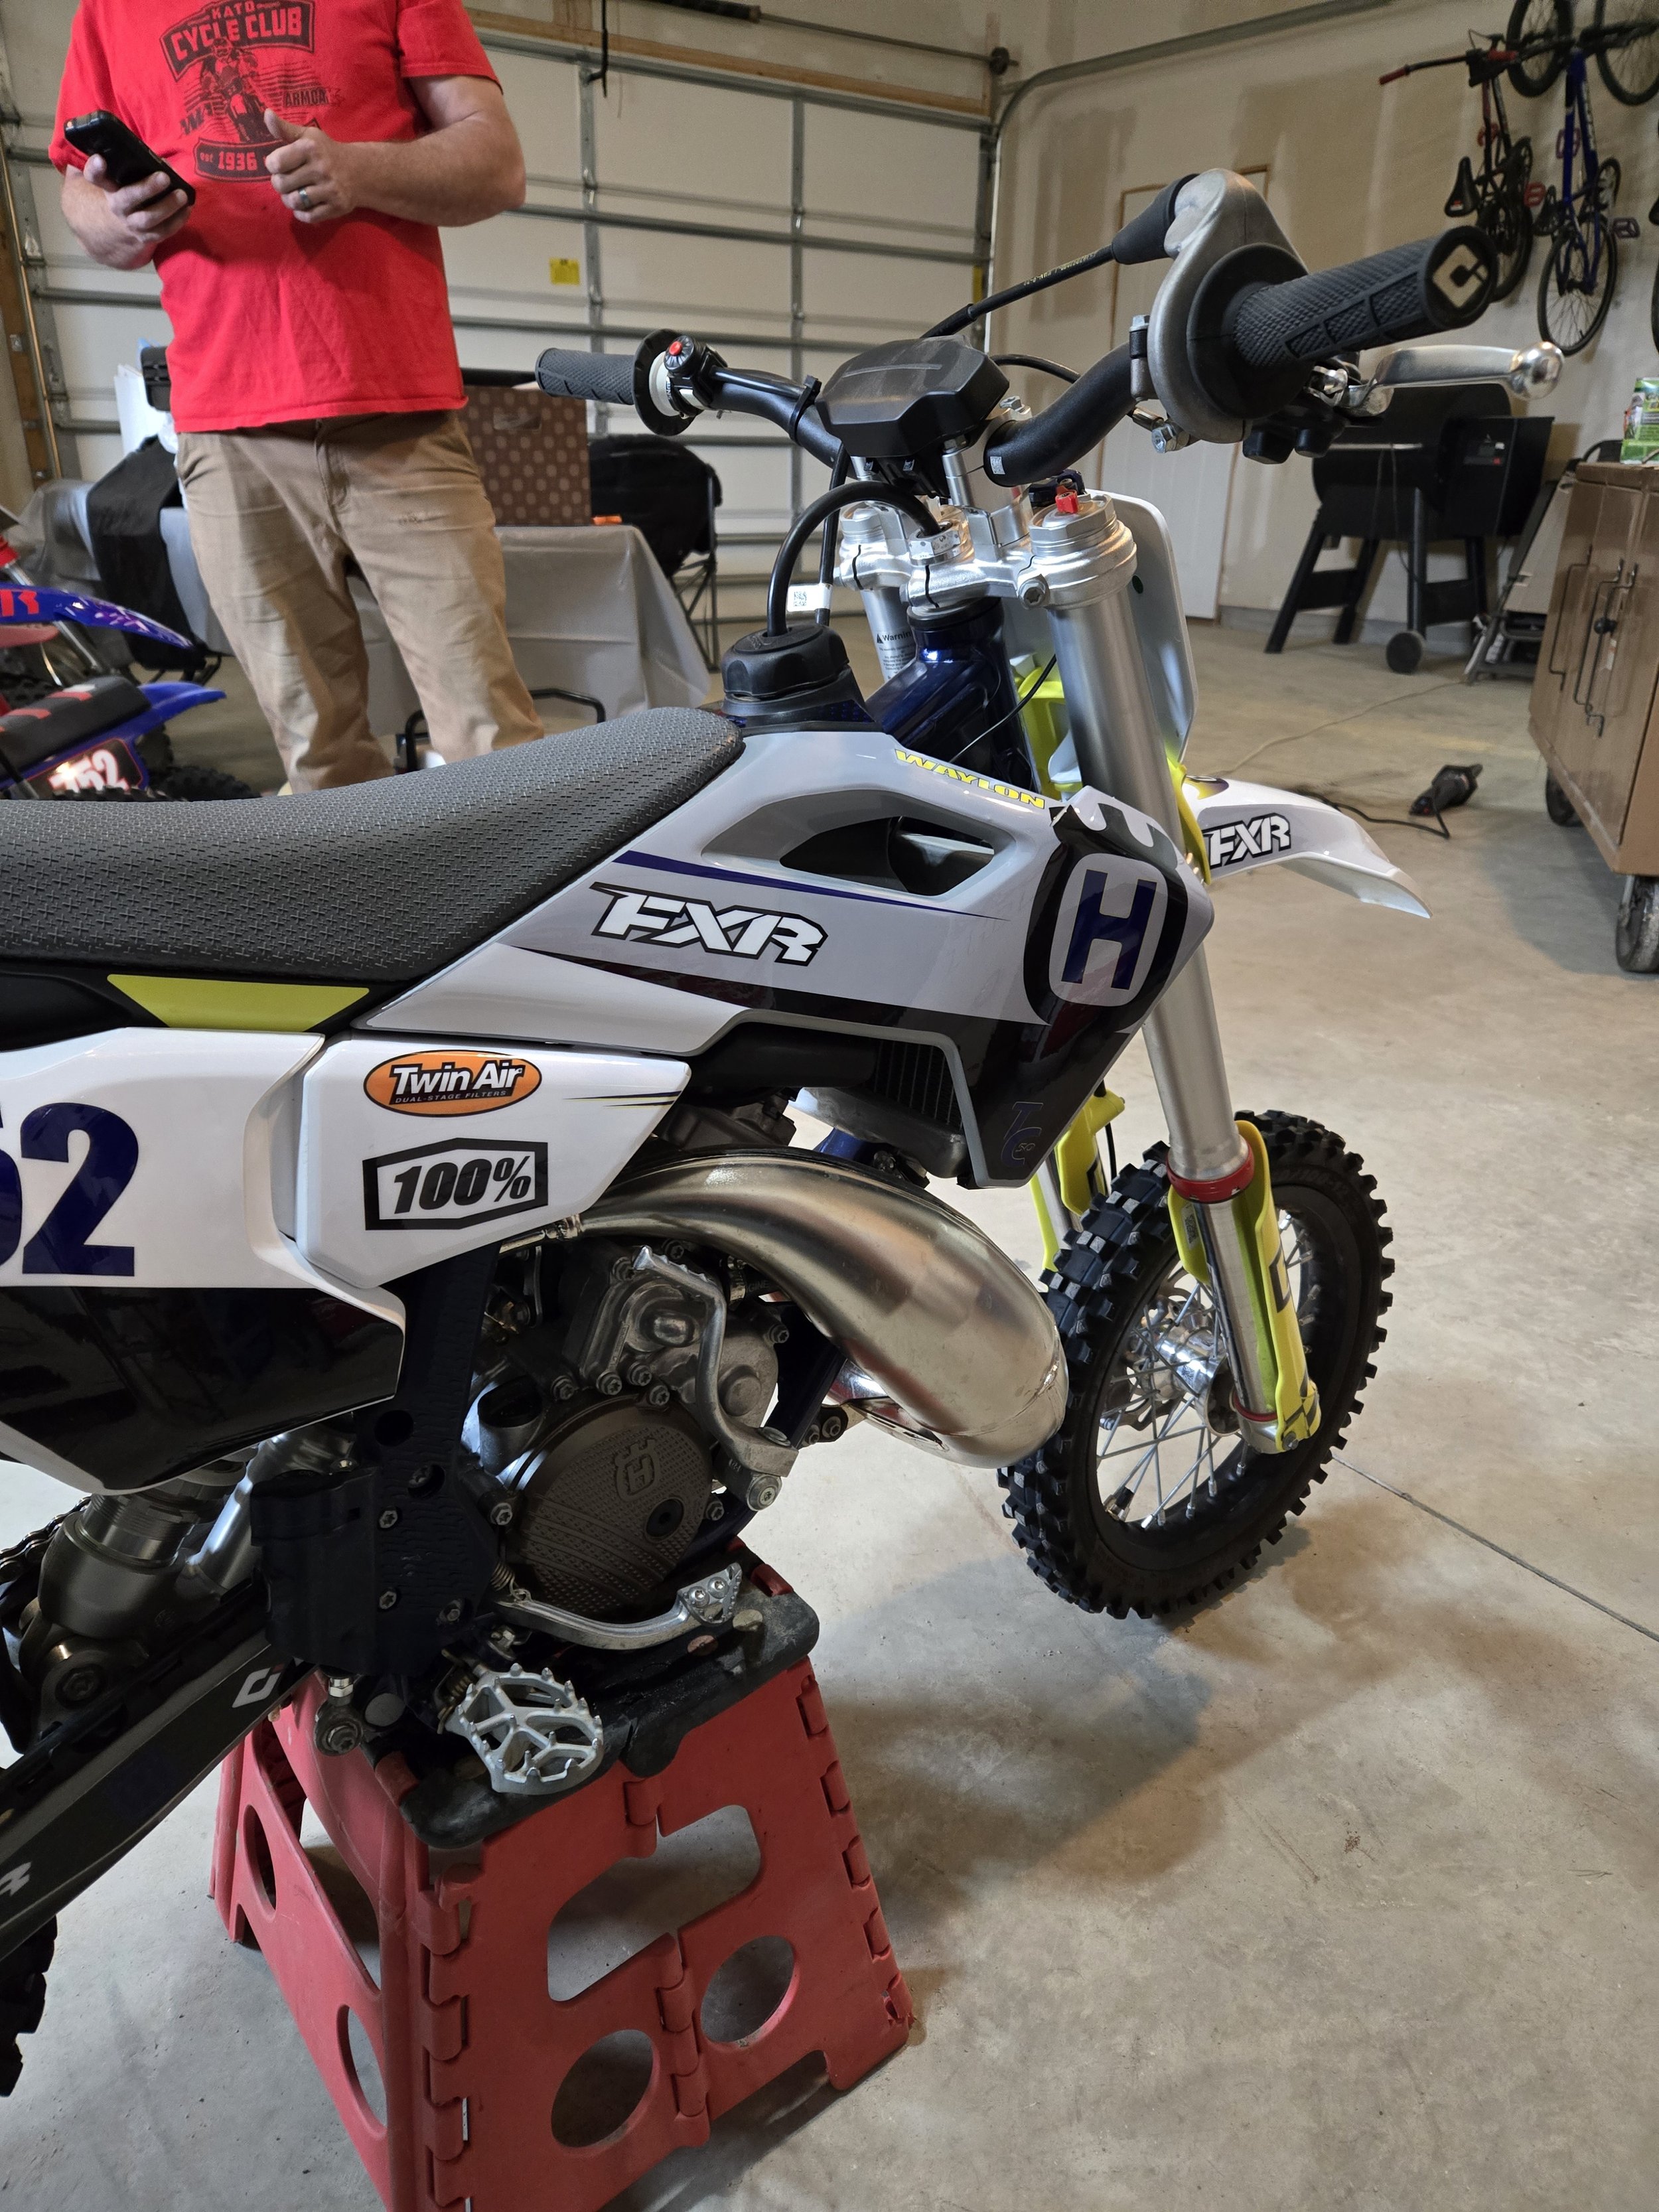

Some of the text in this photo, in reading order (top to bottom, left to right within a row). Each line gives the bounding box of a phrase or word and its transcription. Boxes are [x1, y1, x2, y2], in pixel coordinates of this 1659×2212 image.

[171, 7, 302, 61] CYCLE CLUB
[199, 151, 258, 171] est 1936
[882, 631, 914, 642] Warnin
[895, 749, 1045, 810] WAYLON
[1201, 813, 1291, 870] FXR
[589, 882, 828, 966] FXR
[393, 1061, 523, 1095] Twin Air
[395, 1089, 507, 1104] DUAL-STAGE FILTERS
[394, 1155, 532, 1215] 100%
